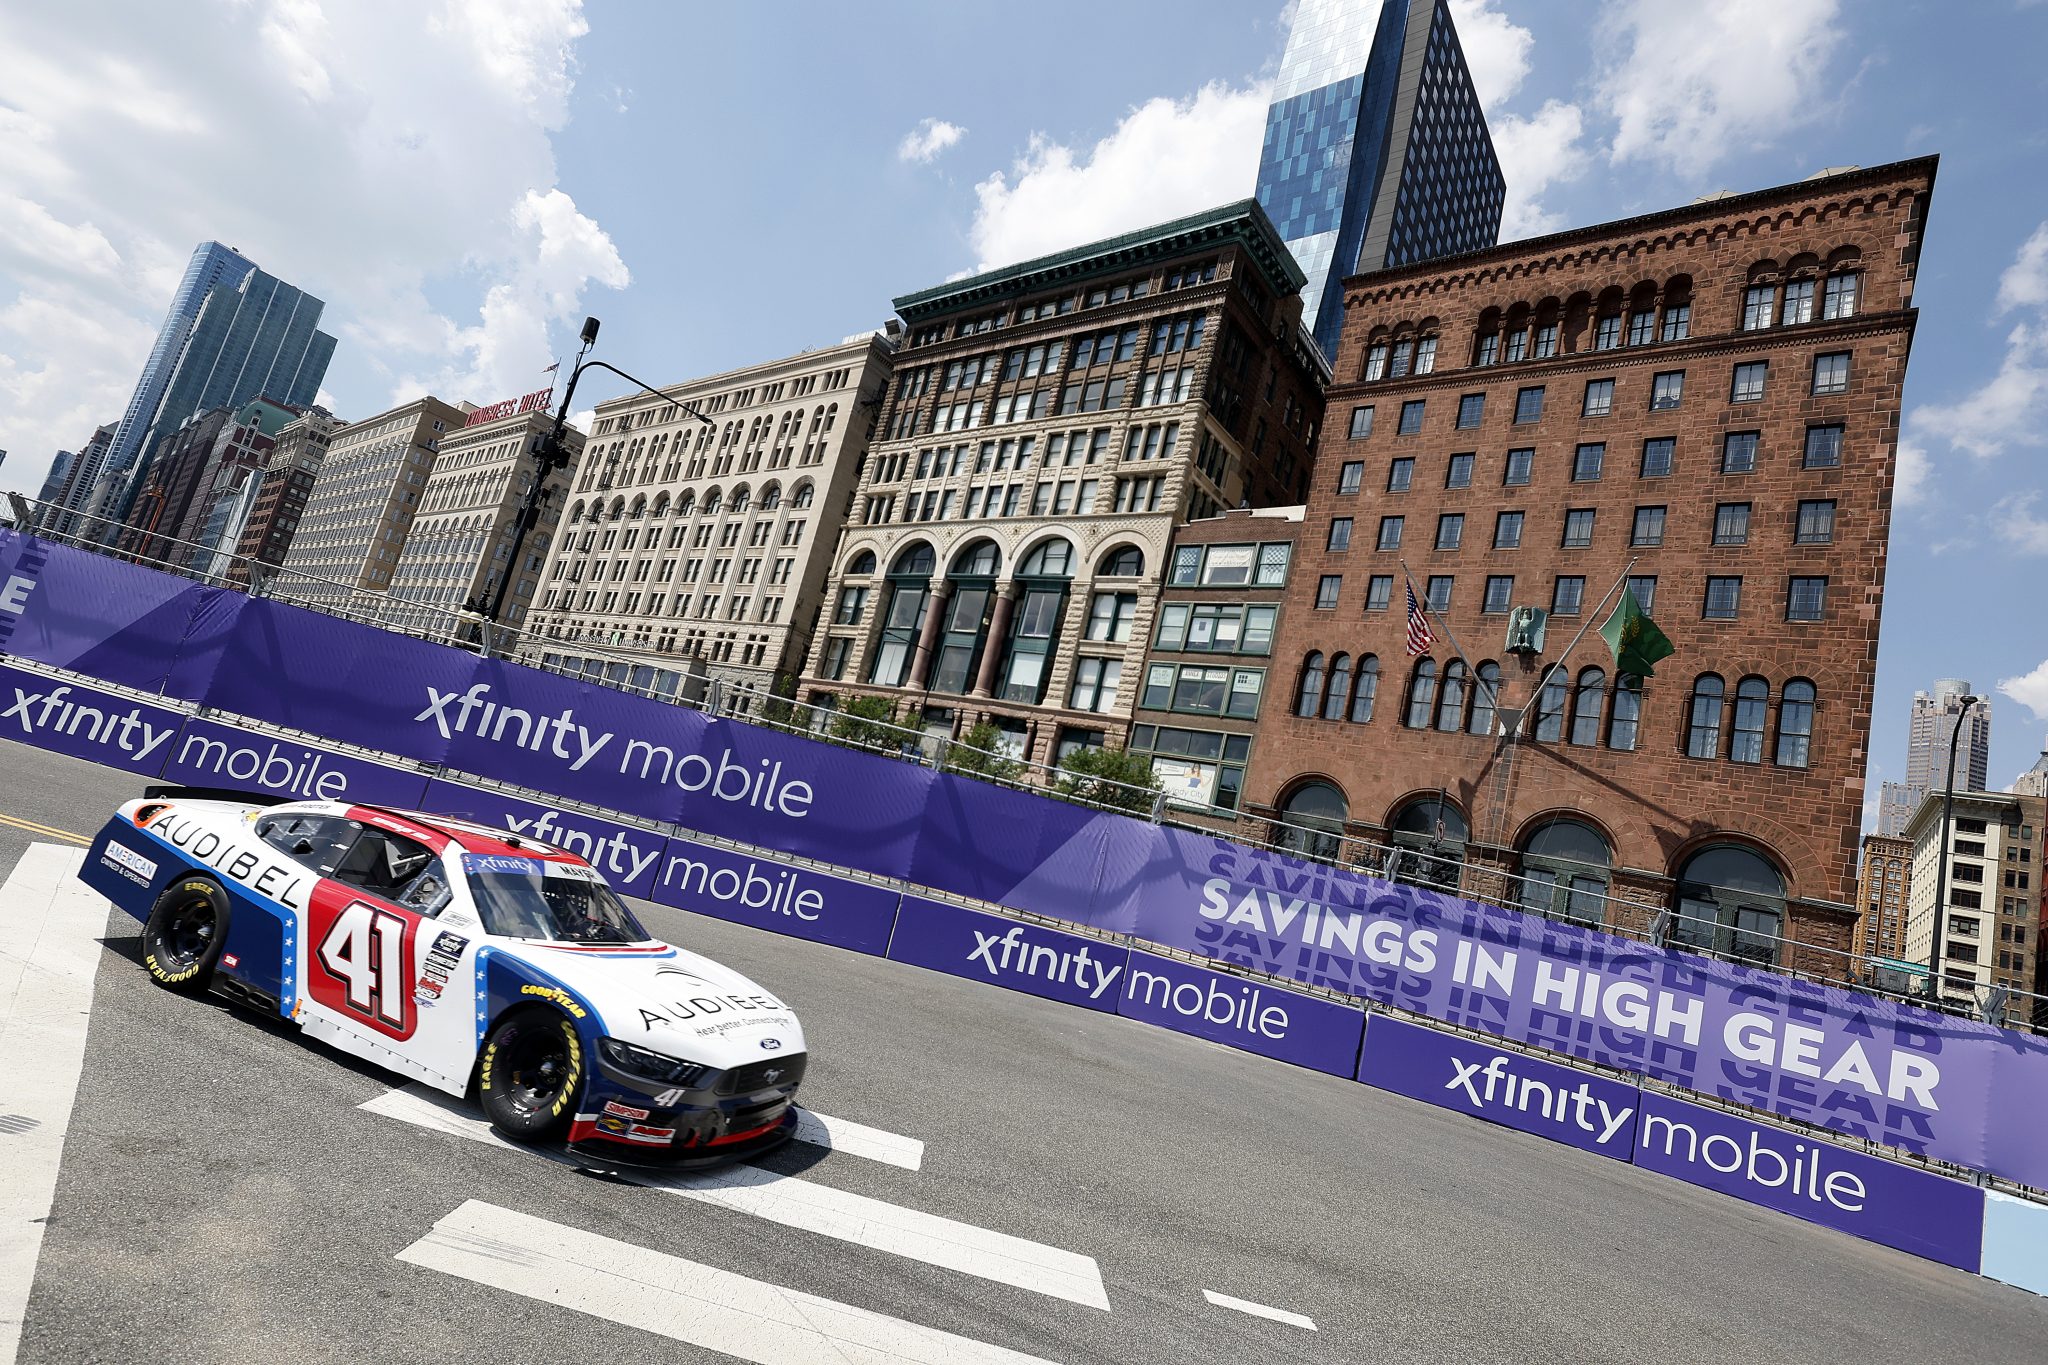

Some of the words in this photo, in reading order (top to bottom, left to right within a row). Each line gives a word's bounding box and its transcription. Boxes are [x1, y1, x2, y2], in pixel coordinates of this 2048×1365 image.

[465, 398, 518, 428] CONGRESS
[518, 387, 553, 414] HOTEL
[1, 687, 174, 760] xfinity
[178, 735, 347, 800] mobile
[414, 684, 614, 771] xfinity
[620, 739, 813, 817] mobile
[107, 844, 155, 877] AMERICAN
[152, 814, 298, 909] AUDIBEL
[477, 856, 533, 874] xfinity
[505, 811, 660, 884] xfinity
[664, 856, 823, 921] mobile
[559, 865, 597, 880] MAYER
[146, 954, 199, 983] GOODYEAR
[317, 900, 406, 1030] 41
[966, 927, 1122, 998] xfinity
[1127, 967, 1289, 1039] mobile
[521, 984, 586, 1019] GOODYEAR
[1199, 878, 1437, 973] SAVINGS
[1453, 940, 1518, 997] IN
[1533, 960, 1704, 1046] HIGH
[1724, 1013, 1940, 1111] GEAR
[481, 1043, 498, 1090] EAGLE
[607, 1103, 646, 1118] SIMPSON
[654, 1088, 685, 1107] 41
[1444, 1056, 1633, 1144] xfinity
[1642, 1113, 1866, 1212] mobile
